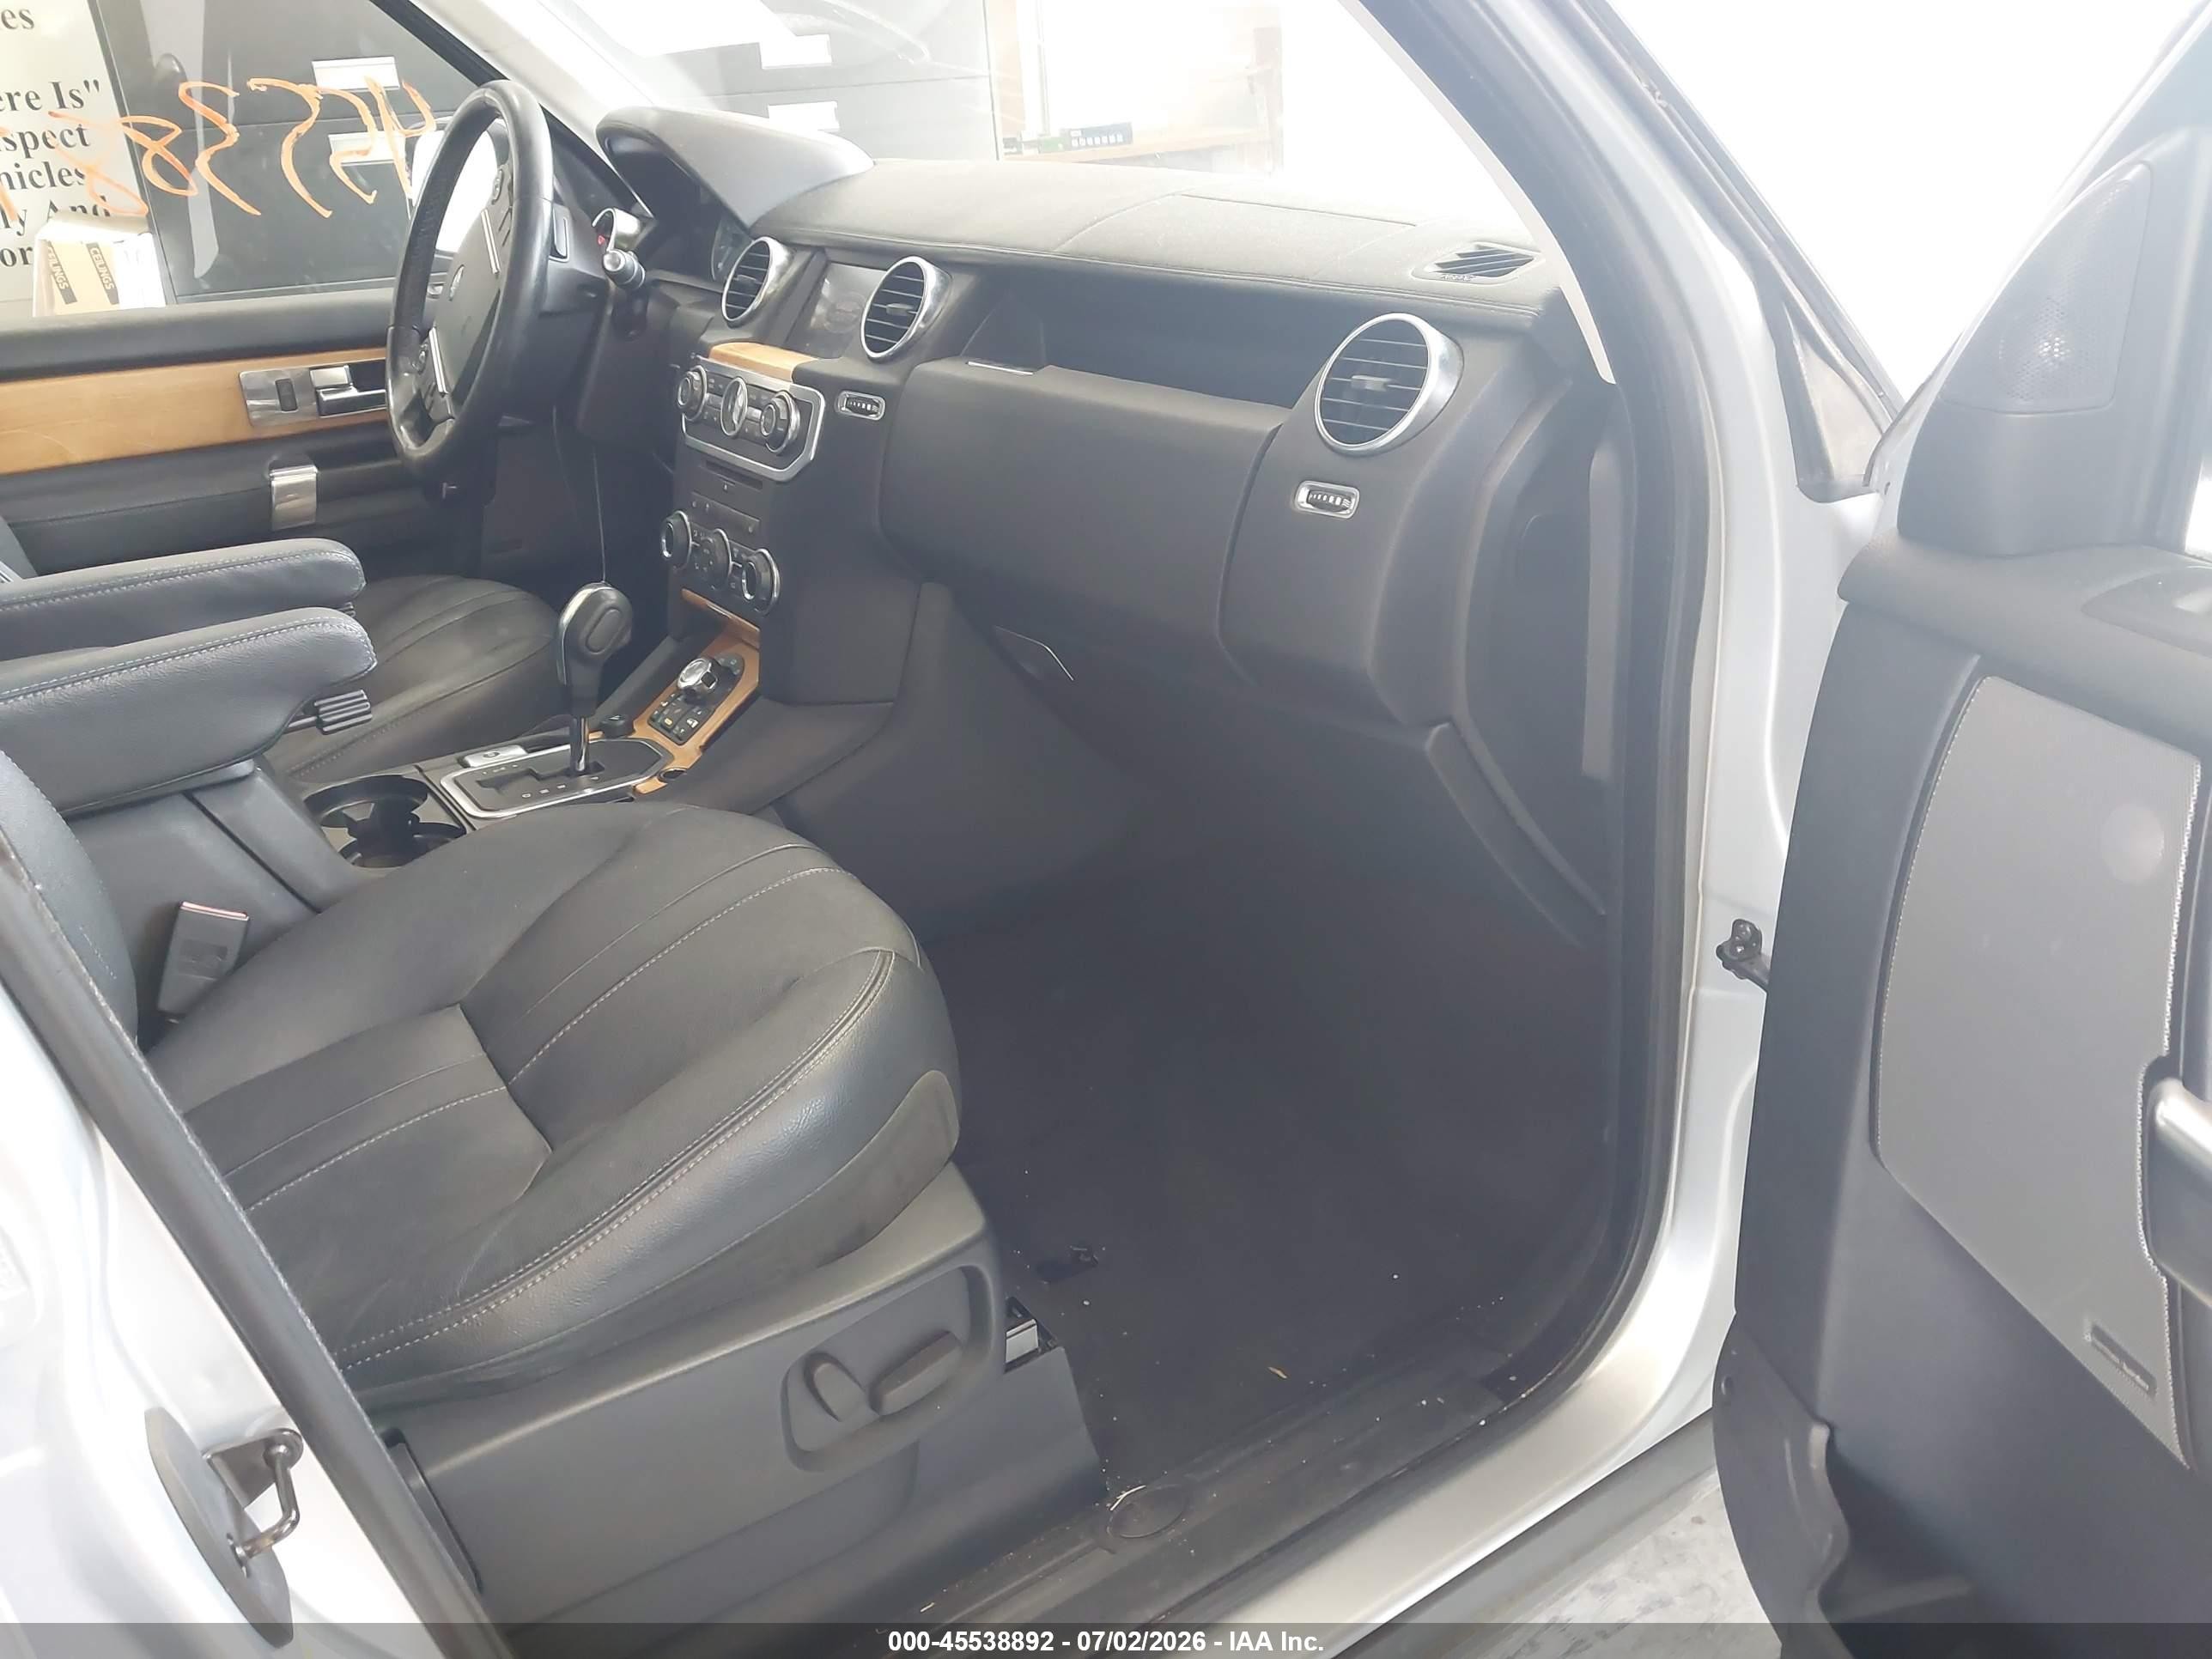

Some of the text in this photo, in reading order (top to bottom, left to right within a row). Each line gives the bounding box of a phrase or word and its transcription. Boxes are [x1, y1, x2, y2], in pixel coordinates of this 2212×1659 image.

[1, 9, 34, 30] es
[48, 79, 100, 109] Is"
[90, 246, 115, 290] CEILINGS
